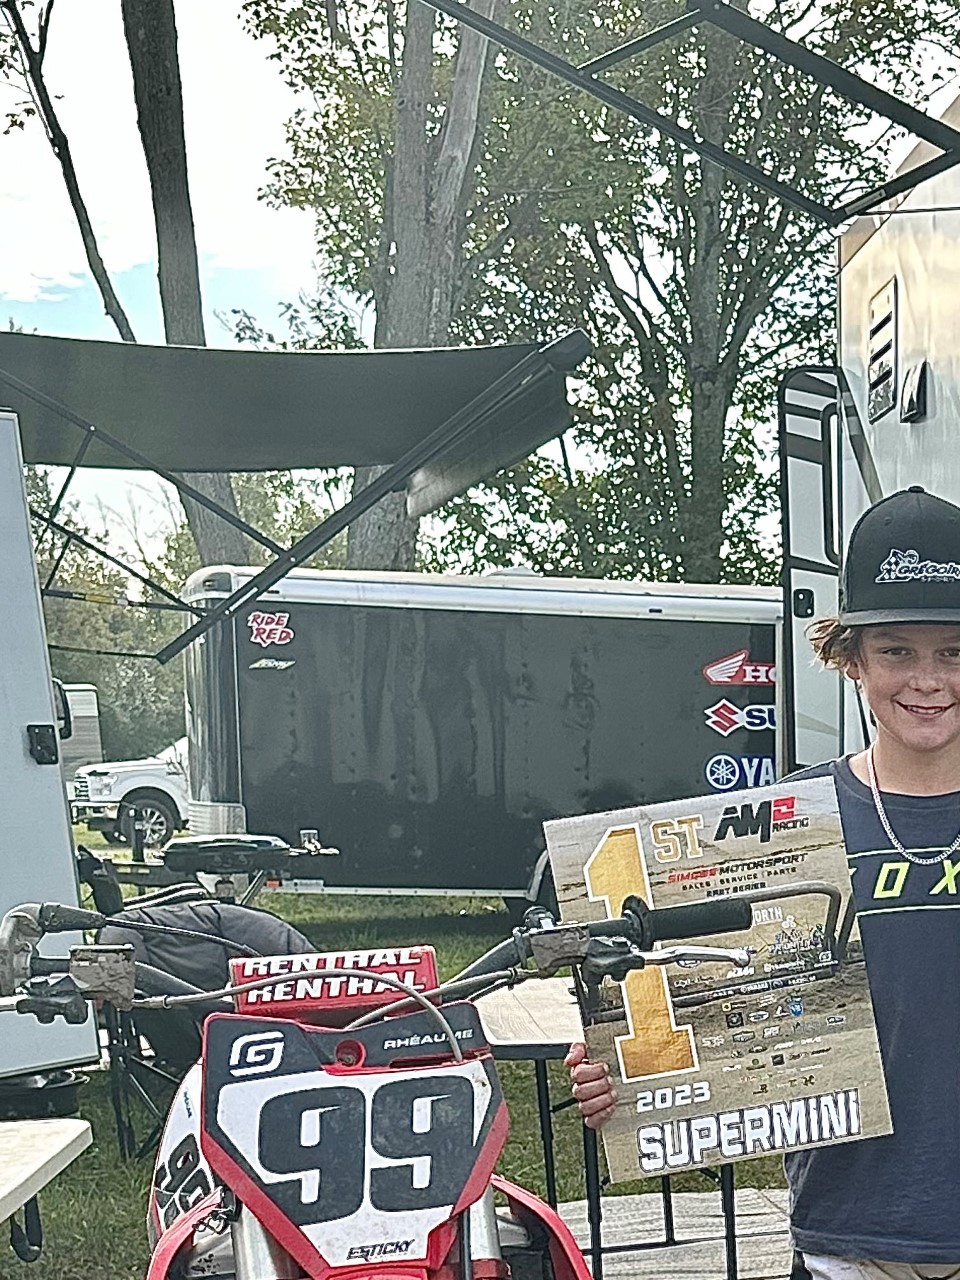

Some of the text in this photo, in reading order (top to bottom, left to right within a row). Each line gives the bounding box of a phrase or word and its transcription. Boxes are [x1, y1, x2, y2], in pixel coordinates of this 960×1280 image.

[250, 613, 288, 627] RIDE
[253, 627, 292, 644] RED
[243, 950, 421, 977] RENTHAL
[247, 970, 427, 1003] RENTHAL
[636, 1081, 711, 1112] 2023
[637, 1087, 861, 1173] SUPERMINI
[258, 1074, 475, 1227] 99
